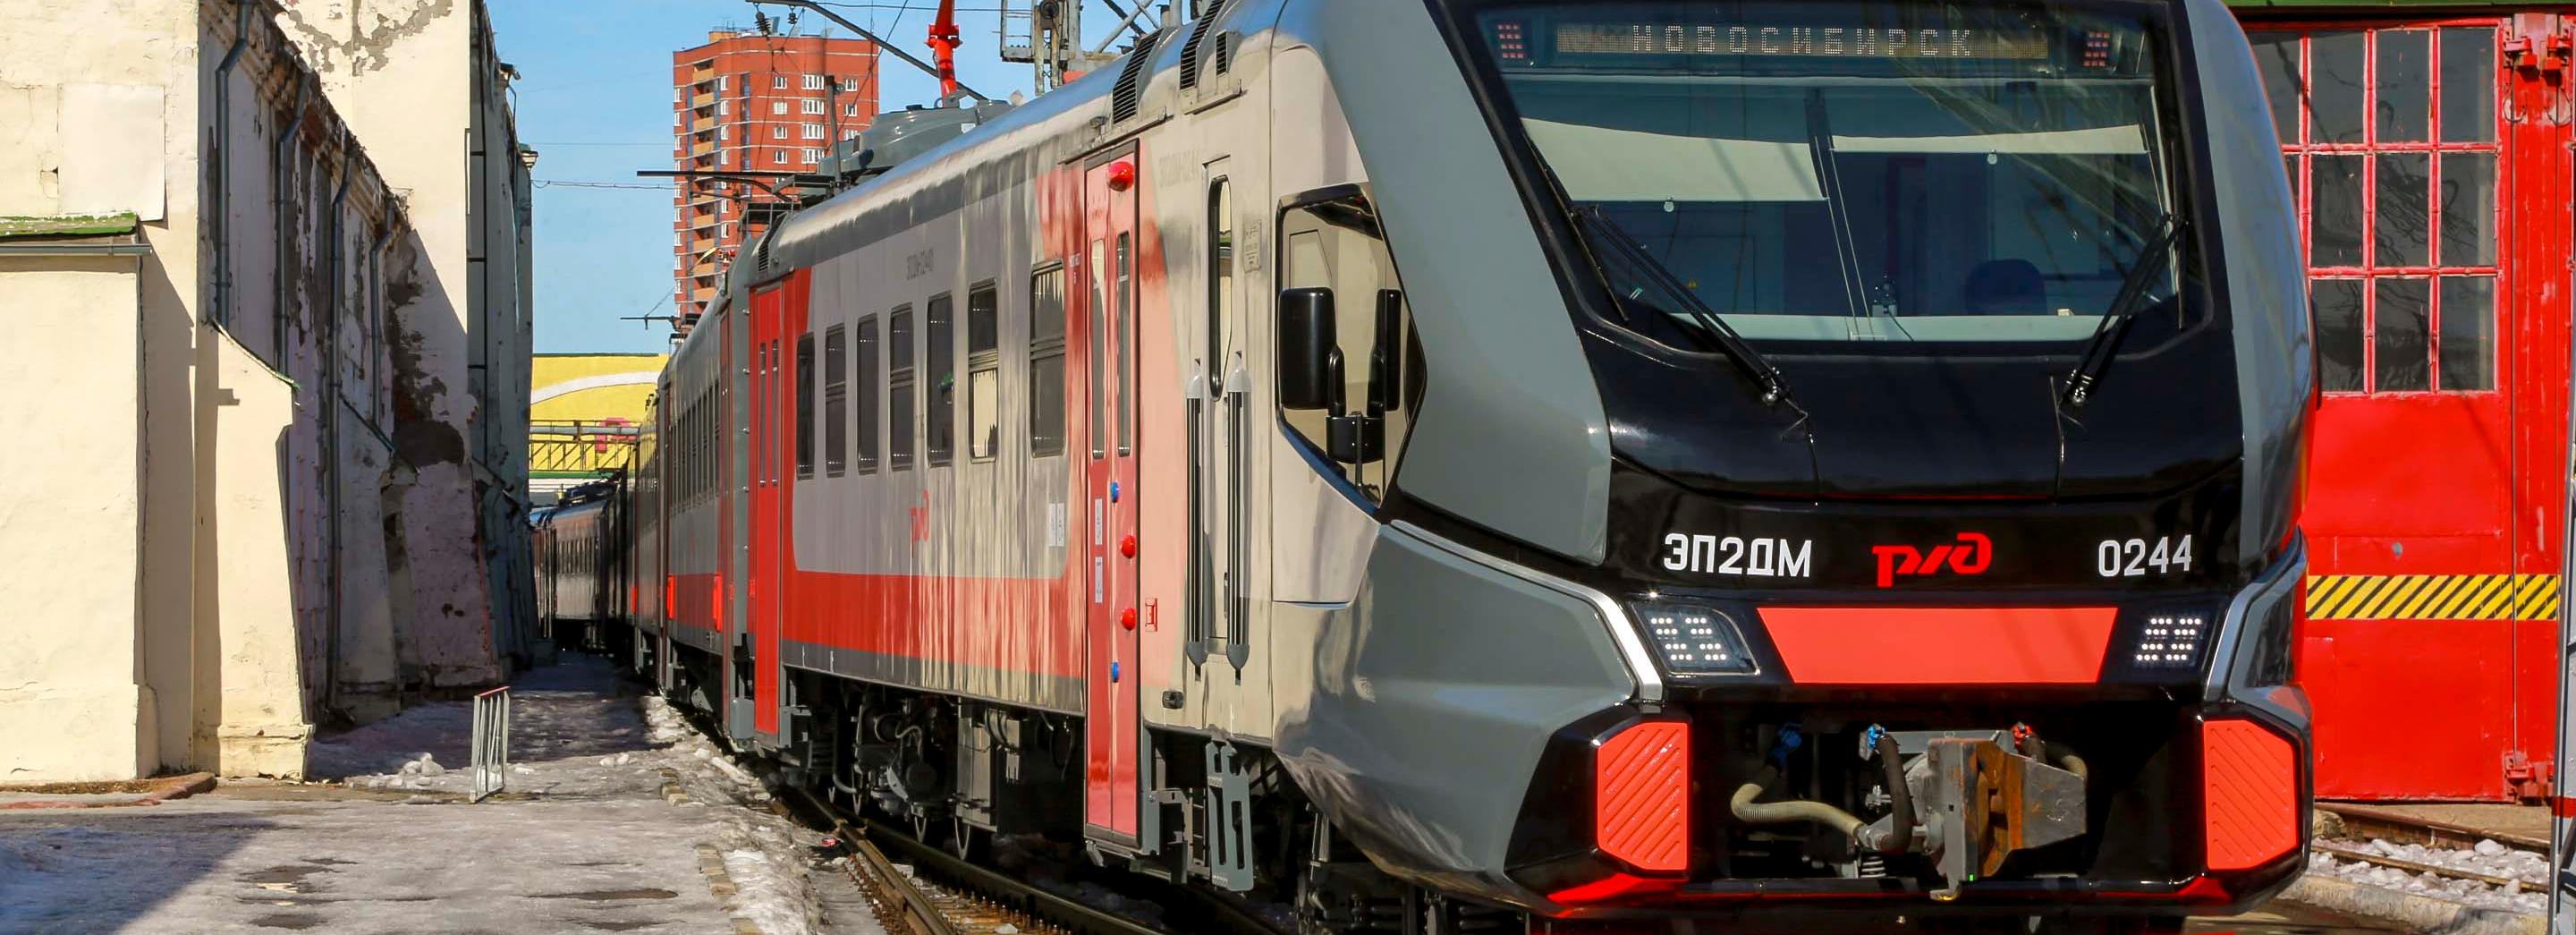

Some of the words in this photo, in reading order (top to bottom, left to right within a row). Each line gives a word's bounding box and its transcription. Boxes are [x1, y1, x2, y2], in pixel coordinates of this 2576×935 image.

[1631, 25, 1970, 56] НОВОСИБИРСК
[1664, 533, 1812, 577] ЭП2ДМ
[2098, 534, 2192, 577] 0244
